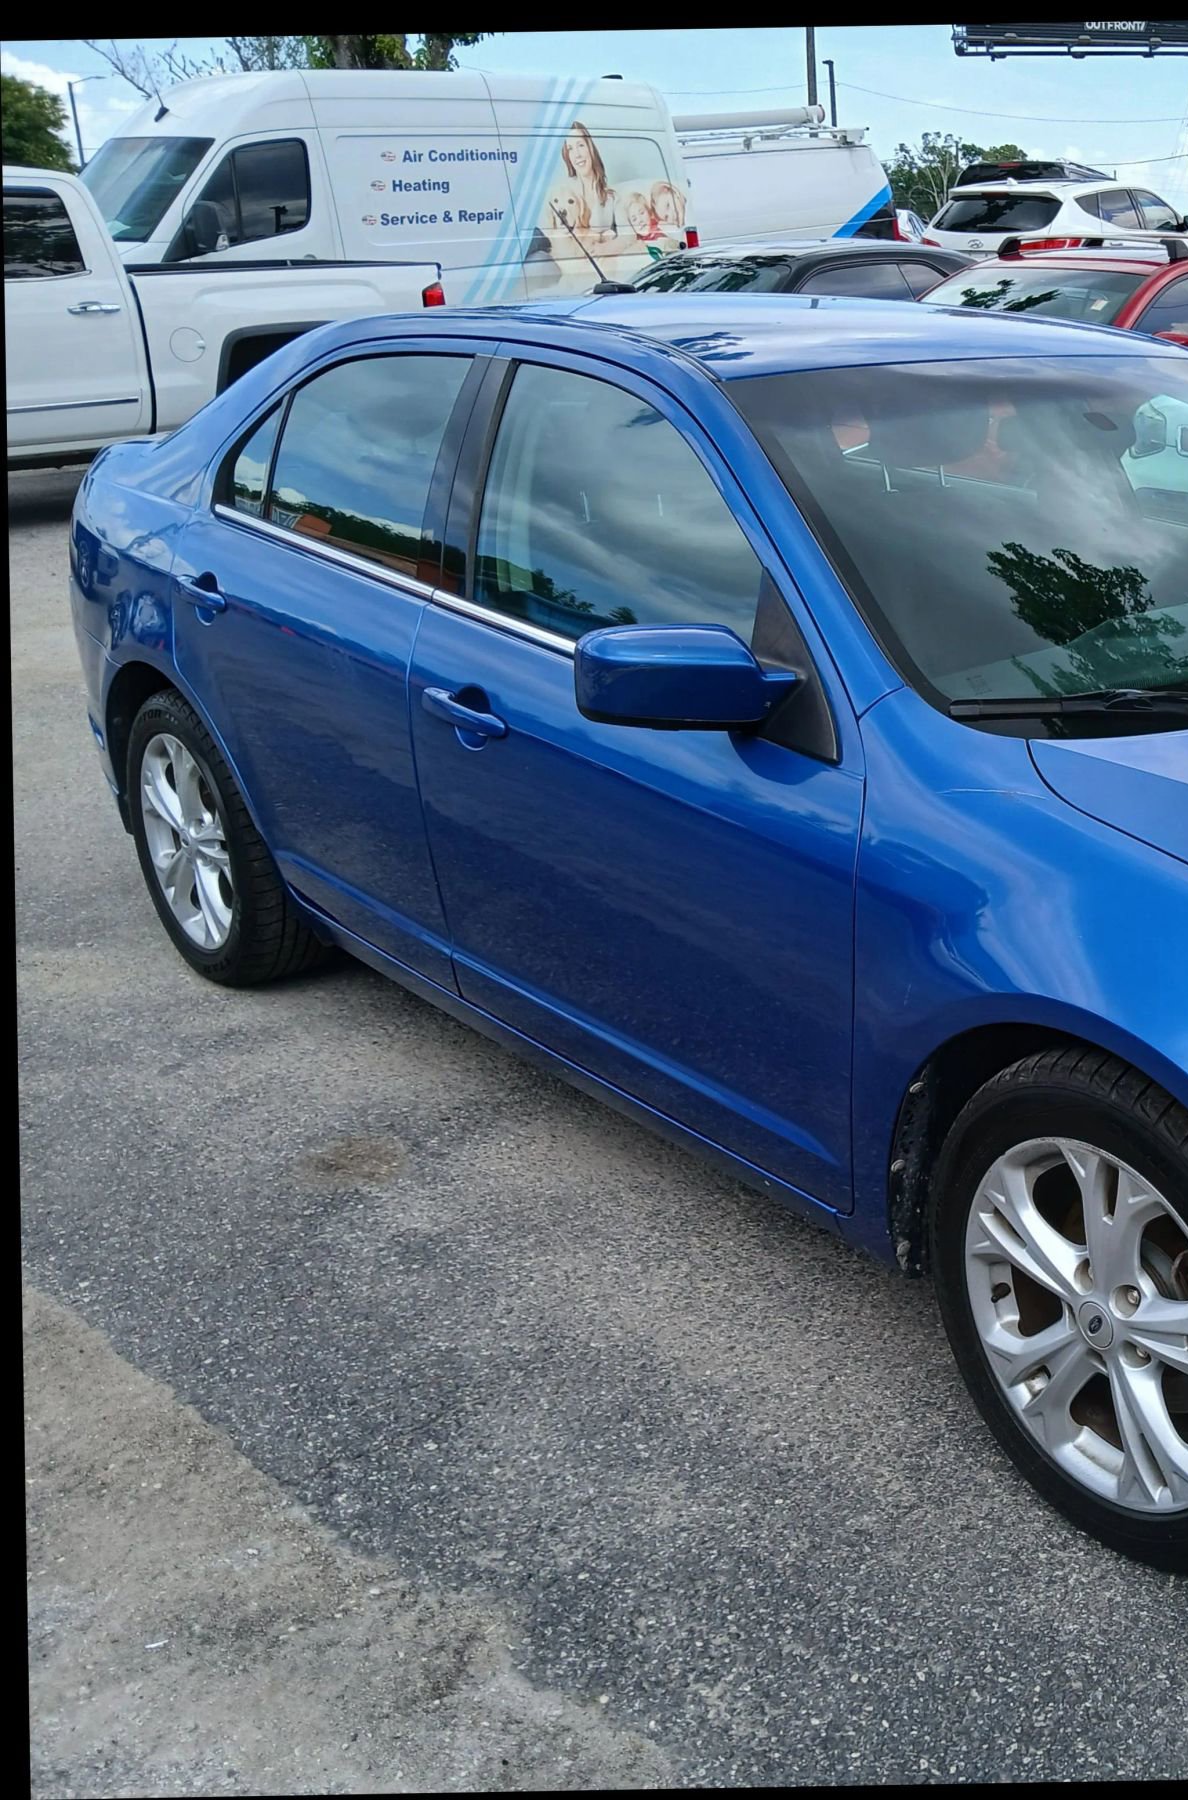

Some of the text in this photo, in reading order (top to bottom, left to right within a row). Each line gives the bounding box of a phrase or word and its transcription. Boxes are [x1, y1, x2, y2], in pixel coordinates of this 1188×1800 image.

[402, 148, 518, 164] Air Conditioning
[392, 179, 450, 193] Heating
[380, 208, 504, 226] Service & Repair
